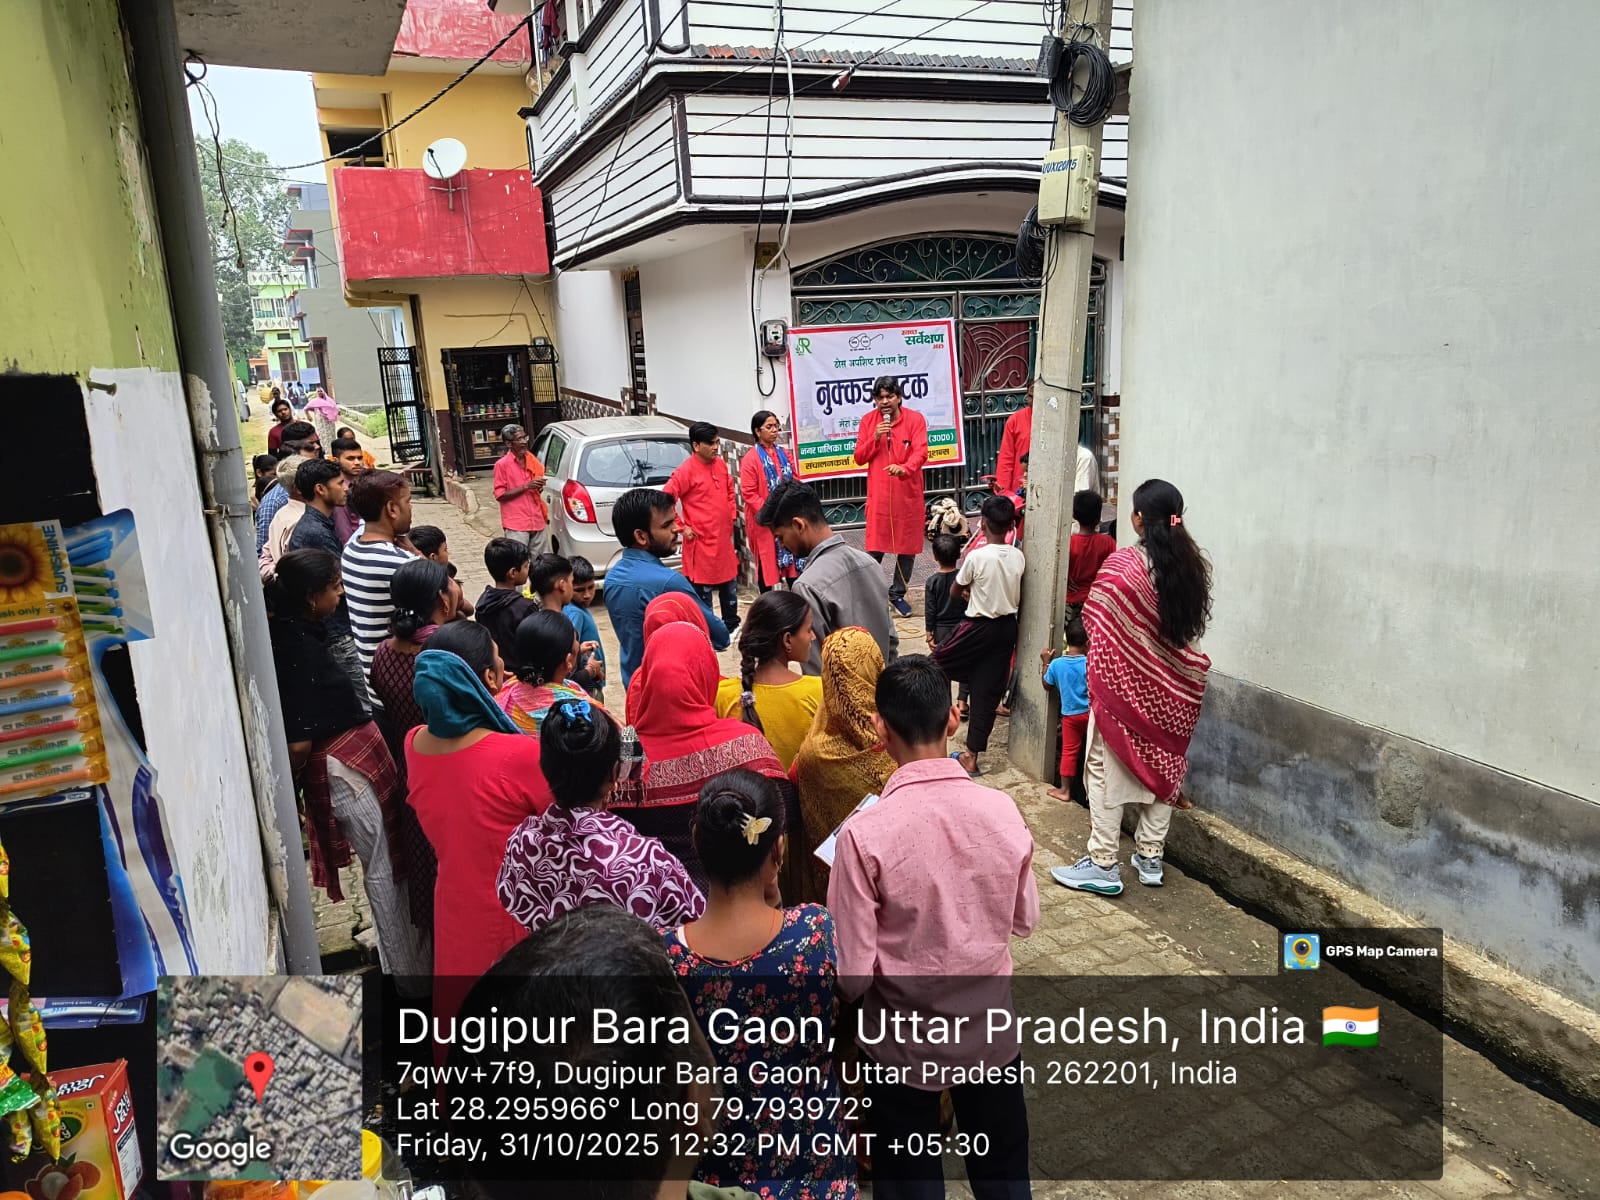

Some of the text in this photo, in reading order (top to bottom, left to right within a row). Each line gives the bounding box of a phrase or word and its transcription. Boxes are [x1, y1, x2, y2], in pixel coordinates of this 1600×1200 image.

[904, 331, 944, 345] सर्वेक्षण
[898, 354, 908, 367] हेतु
[800, 447, 816, 456] नगर
[817, 443, 842, 453] पालिका
[42, 525, 68, 593] SUNSHINE
[18, 606, 40, 617] only
